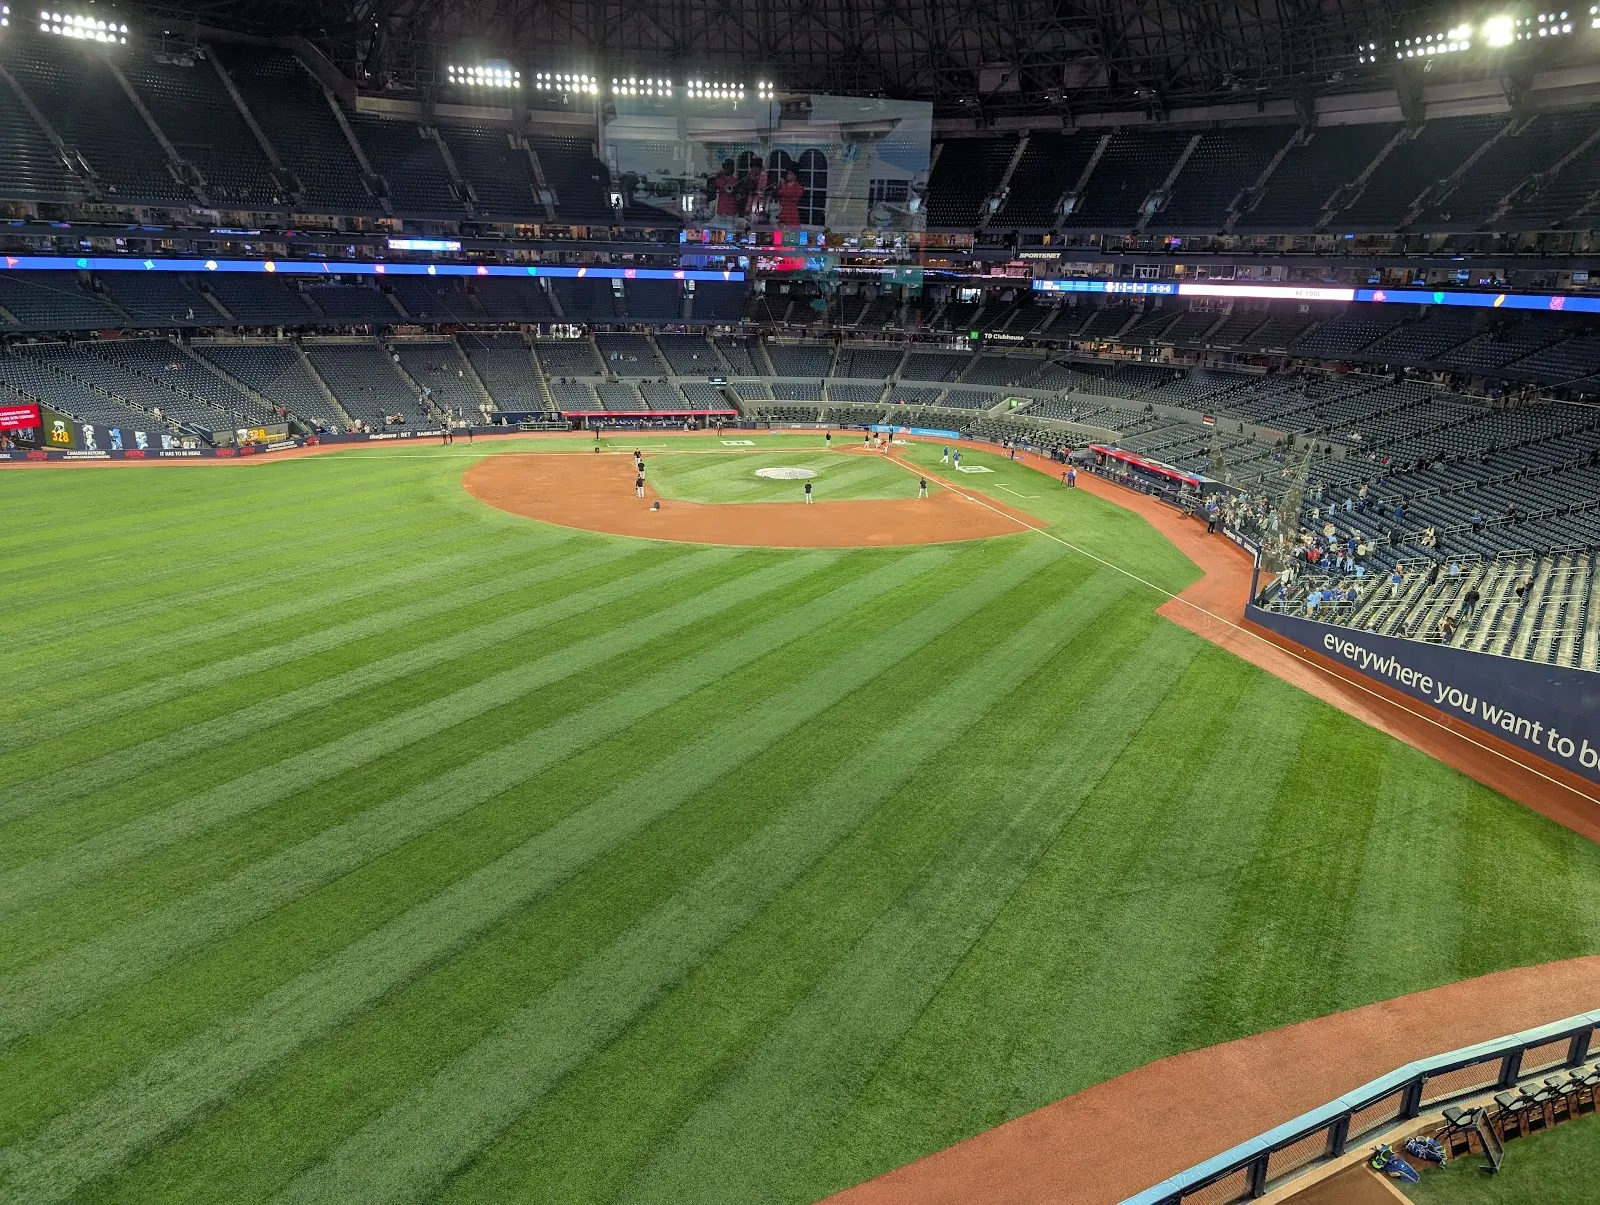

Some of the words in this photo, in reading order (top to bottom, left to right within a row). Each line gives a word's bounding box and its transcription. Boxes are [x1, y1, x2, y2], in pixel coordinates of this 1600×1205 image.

[993, 333, 1024, 341] Clubhouse
[52, 430, 69, 442] 328
[27, 451, 48, 459] HEINZ
[125, 450, 146, 458] HEINZ
[1323, 632, 1434, 695] everywhere
[1434, 680, 1478, 714] you
[1482, 701, 1544, 745] want
[1547, 727, 1575, 758] to
